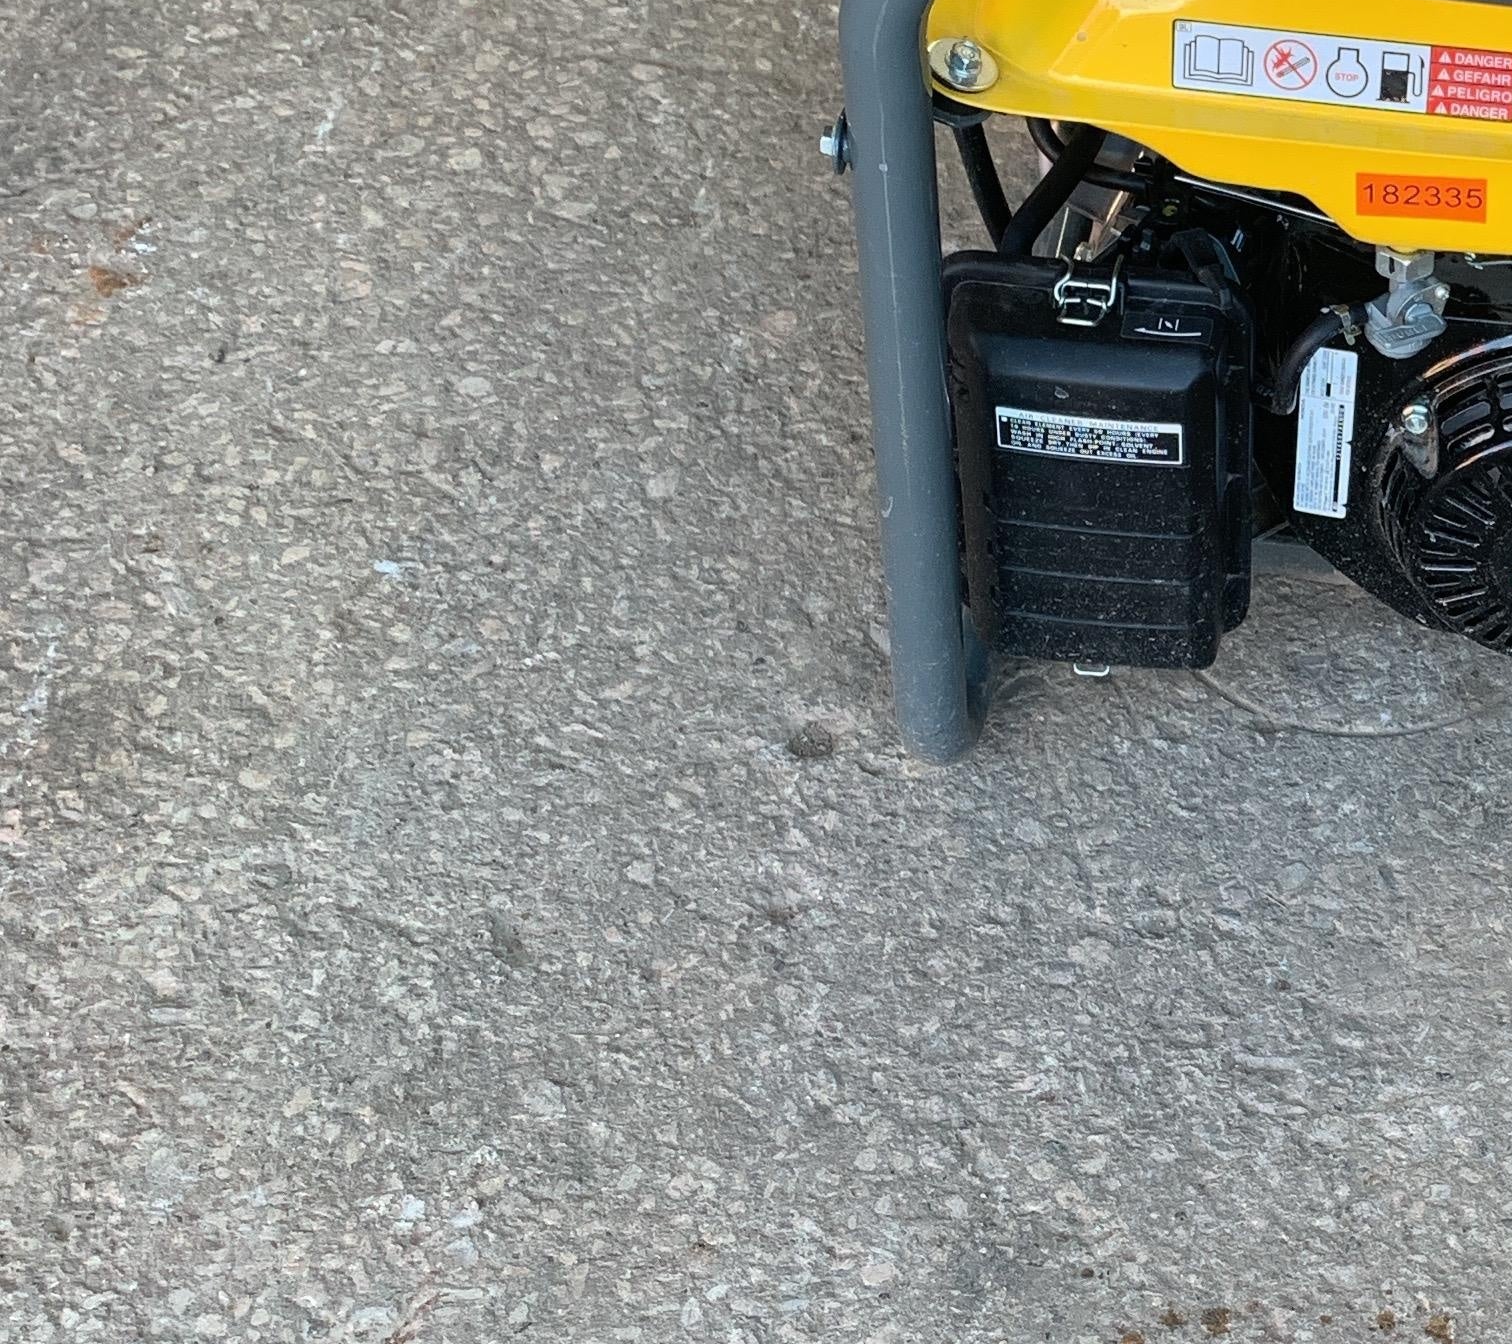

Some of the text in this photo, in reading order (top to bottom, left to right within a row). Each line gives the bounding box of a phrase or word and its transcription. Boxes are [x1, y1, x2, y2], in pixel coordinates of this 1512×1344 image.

[1335, 72, 1359, 82] STOP
[1453, 69, 1512, 86] GEFAHR
[1448, 86, 1512, 104] PELIGRO
[1450, 103, 1509, 120] DANGER
[1361, 182, 1484, 209] 182335
[1088, 419, 1158, 433] MAINTENANCE
